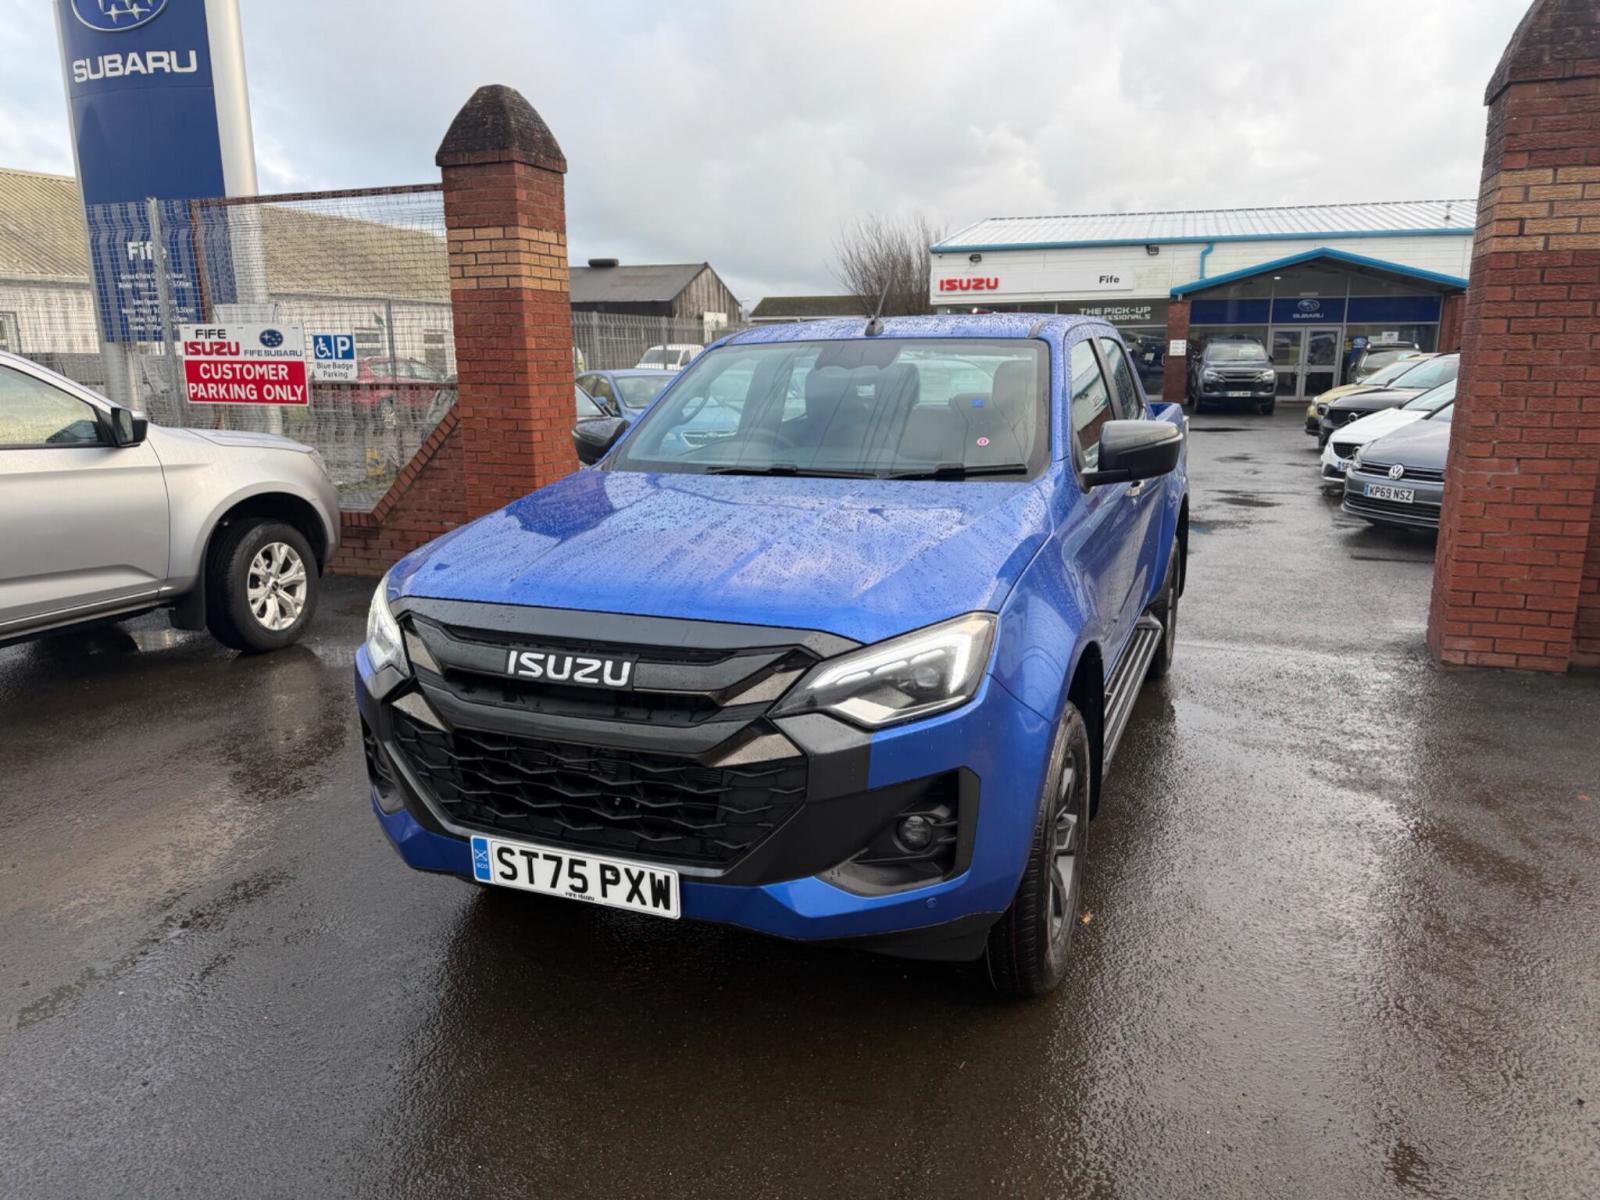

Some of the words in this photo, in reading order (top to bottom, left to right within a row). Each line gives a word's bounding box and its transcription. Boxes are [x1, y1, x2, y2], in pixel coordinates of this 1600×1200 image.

[73, 50, 198, 83] SUBARU
[939, 277, 999, 291] ISUZU
[1098, 275, 1120, 284] Fife
[1079, 307, 1102, 316] THE
[1103, 306, 1151, 315] PICK-UP
[195, 329, 226, 339] FIFE
[184, 341, 239, 356] ISUZU
[243, 349, 264, 358] FIFE
[264, 349, 303, 358] SUBARU
[199, 363, 289, 381] CUSTOMER
[316, 361, 332, 370] Blue
[332, 361, 354, 371] Badge
[323, 370, 349, 379] Parking
[188, 382, 257, 400] PARKING
[262, 384, 304, 401] ONLY
[1369, 485, 1393, 499] KP69
[1393, 487, 1412, 502] NSZ
[507, 650, 631, 687] ISUZU
[496, 846, 589, 894] ST75
[599, 863, 671, 911] PXW
